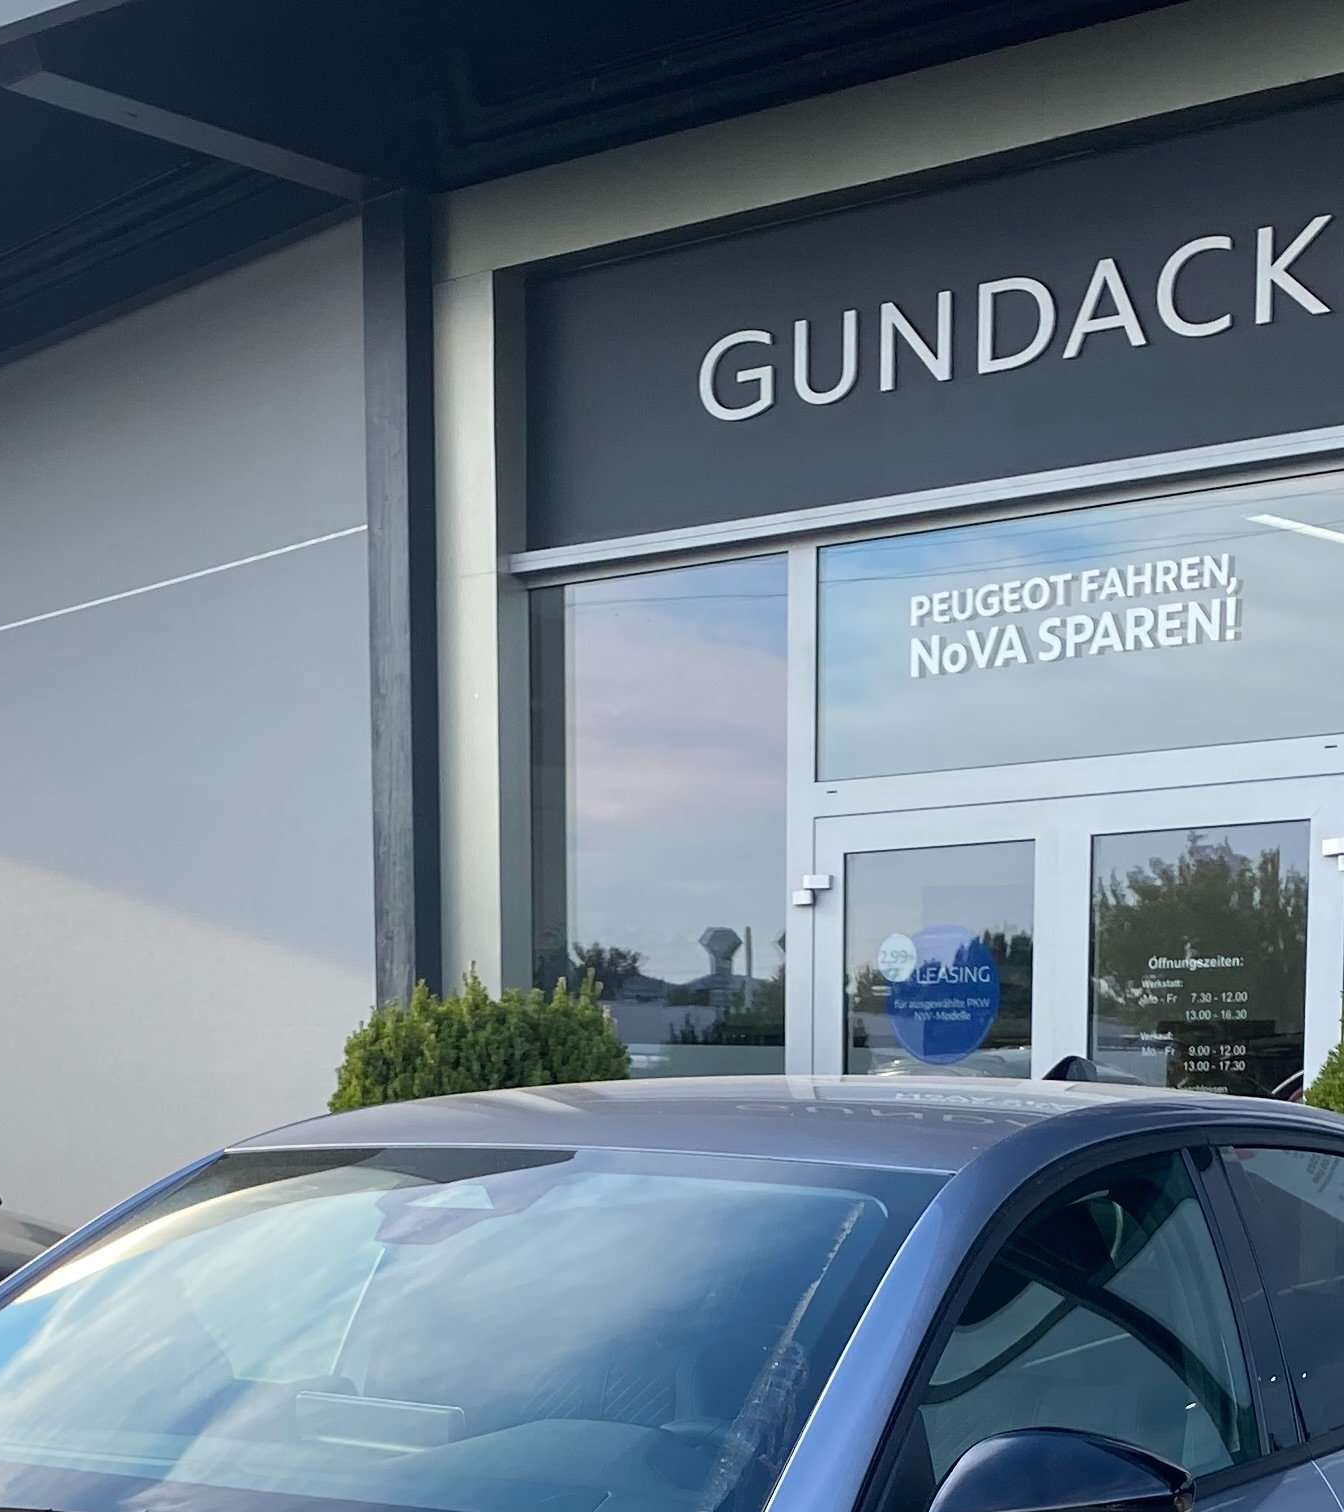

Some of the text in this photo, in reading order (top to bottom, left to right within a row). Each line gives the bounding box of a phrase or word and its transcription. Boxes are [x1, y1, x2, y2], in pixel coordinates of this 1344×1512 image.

[910, 553, 1237, 626] PEUGEOT FAHREN,
[910, 596, 1237, 678] NoVA SPAREN!
[1148, 956, 1244, 971] Öffnungszeiten:
[916, 965, 991, 984] LEASING
[1167, 993, 1178, 1003] Fr
[1191, 992, 1212, 1003] 7.30
[1221, 991, 1248, 1002] 12.00
[1185, 1010, 1211, 1020] 13.00
[1188, 1045, 1210, 1056] 9.00
[1219, 1045, 1246, 1056] 12.00
[1184, 1061, 1210, 1072] 13.00
[1219, 1060, 1246, 1071] 17.30
